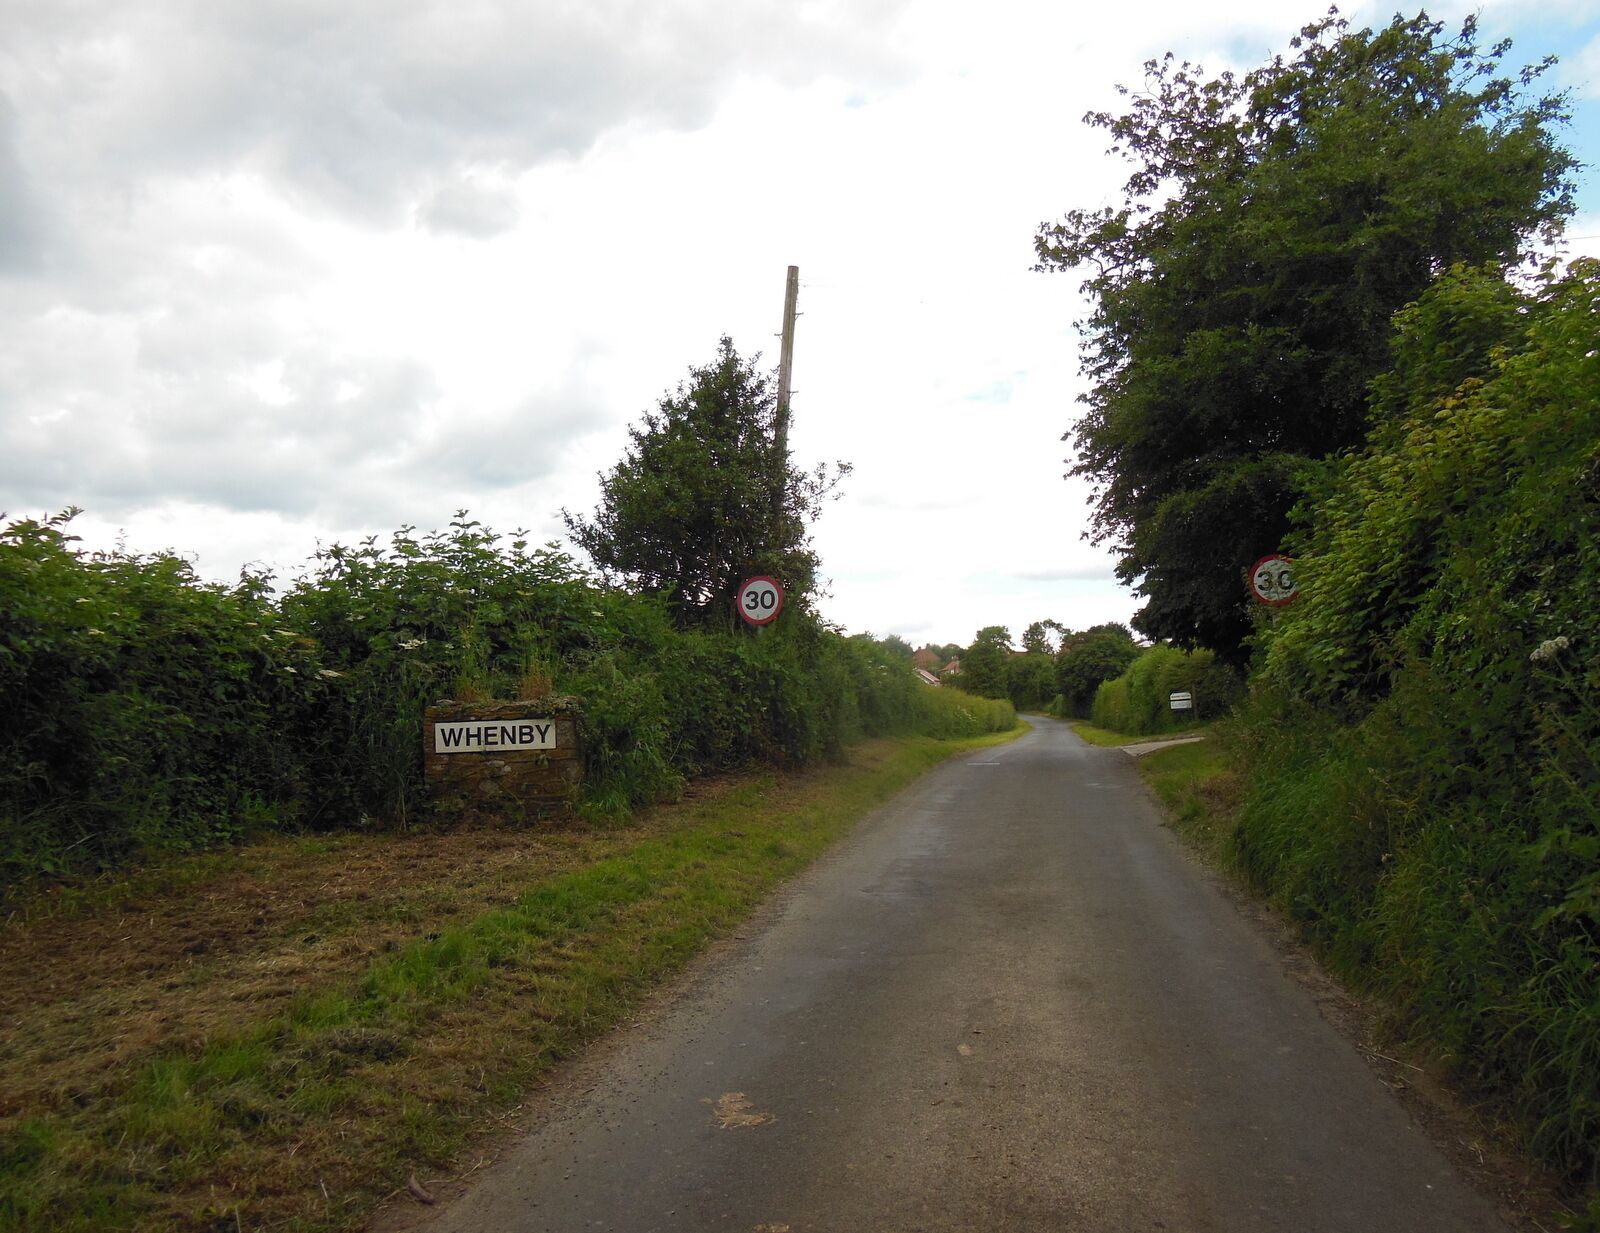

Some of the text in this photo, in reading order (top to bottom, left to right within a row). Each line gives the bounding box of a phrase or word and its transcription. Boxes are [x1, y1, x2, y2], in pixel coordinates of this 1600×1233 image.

[1257, 570, 1294, 590] 30
[745, 590, 775, 610] 30
[440, 724, 551, 747] WHENBY
